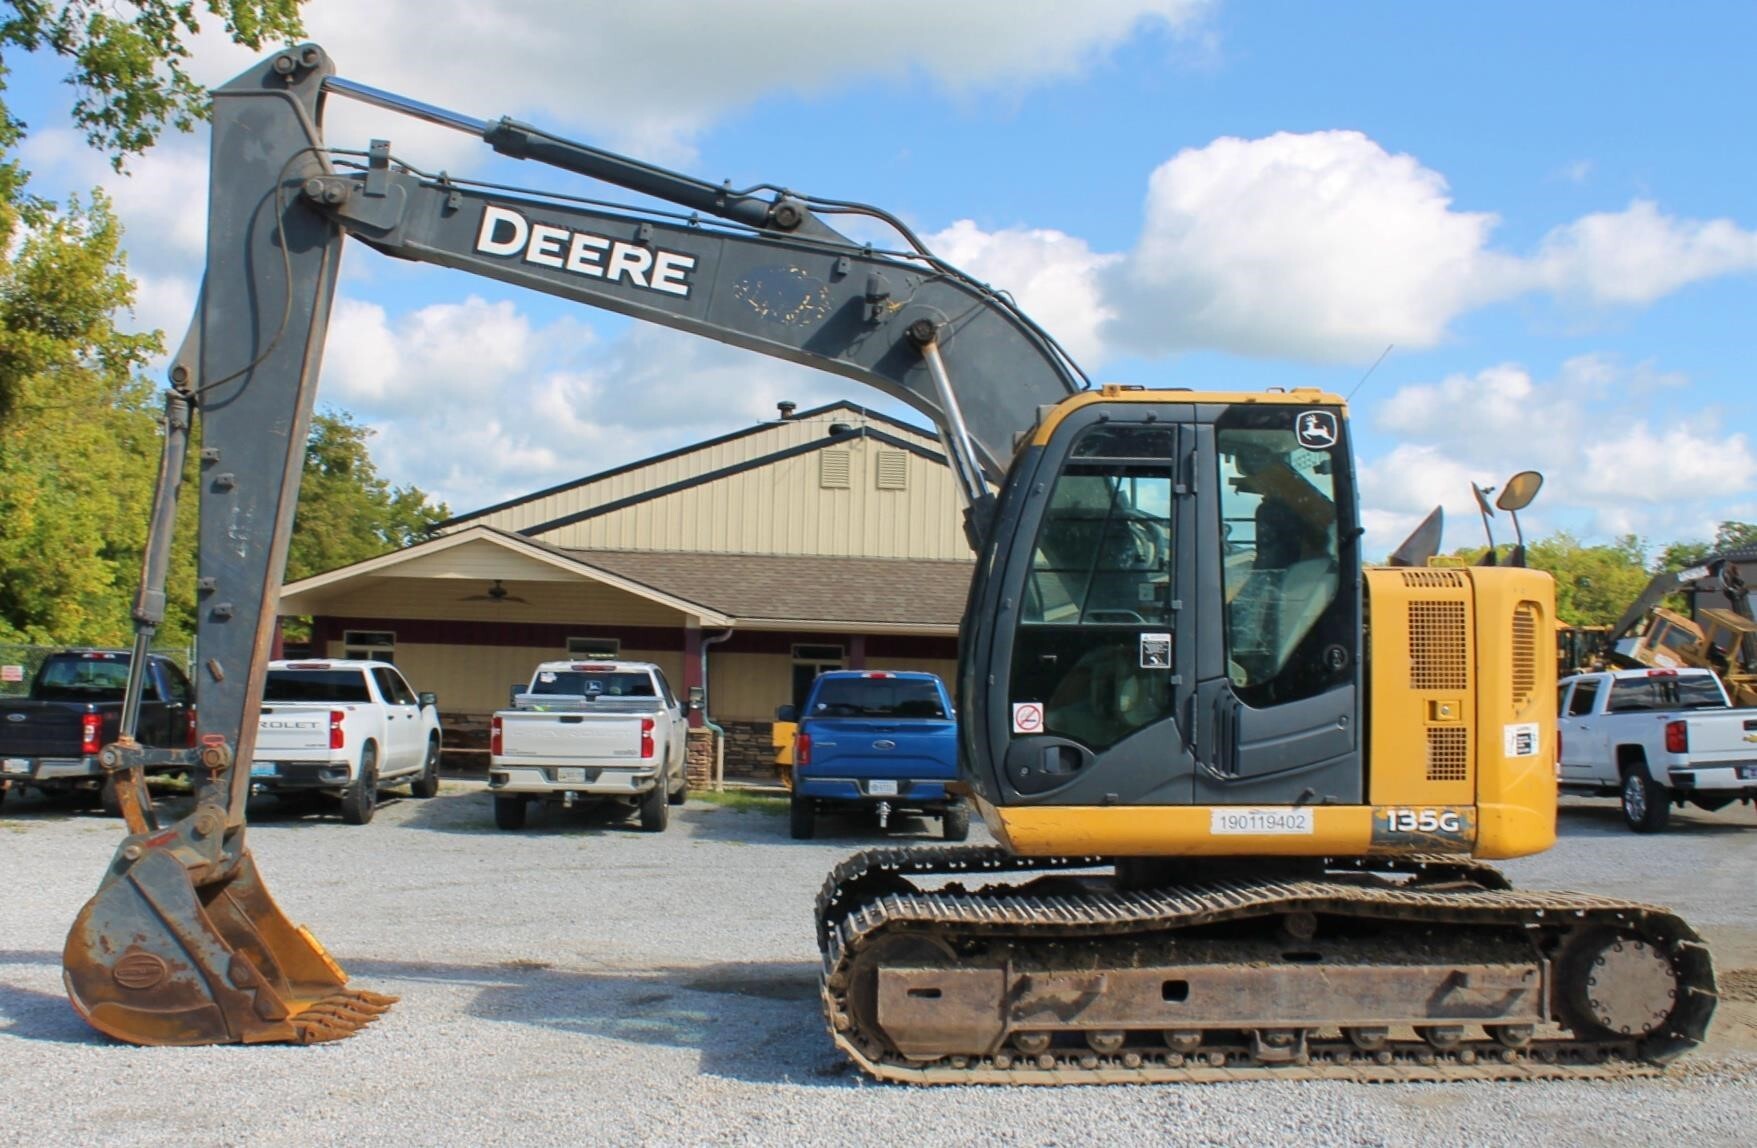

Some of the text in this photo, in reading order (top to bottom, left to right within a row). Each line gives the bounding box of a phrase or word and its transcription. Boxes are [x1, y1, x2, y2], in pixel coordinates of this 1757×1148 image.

[476, 204, 695, 297] DEERE
[259, 721, 321, 729] ROLET
[1220, 815, 1305, 829] 190119402
[1387, 809, 1459, 832] 135G
